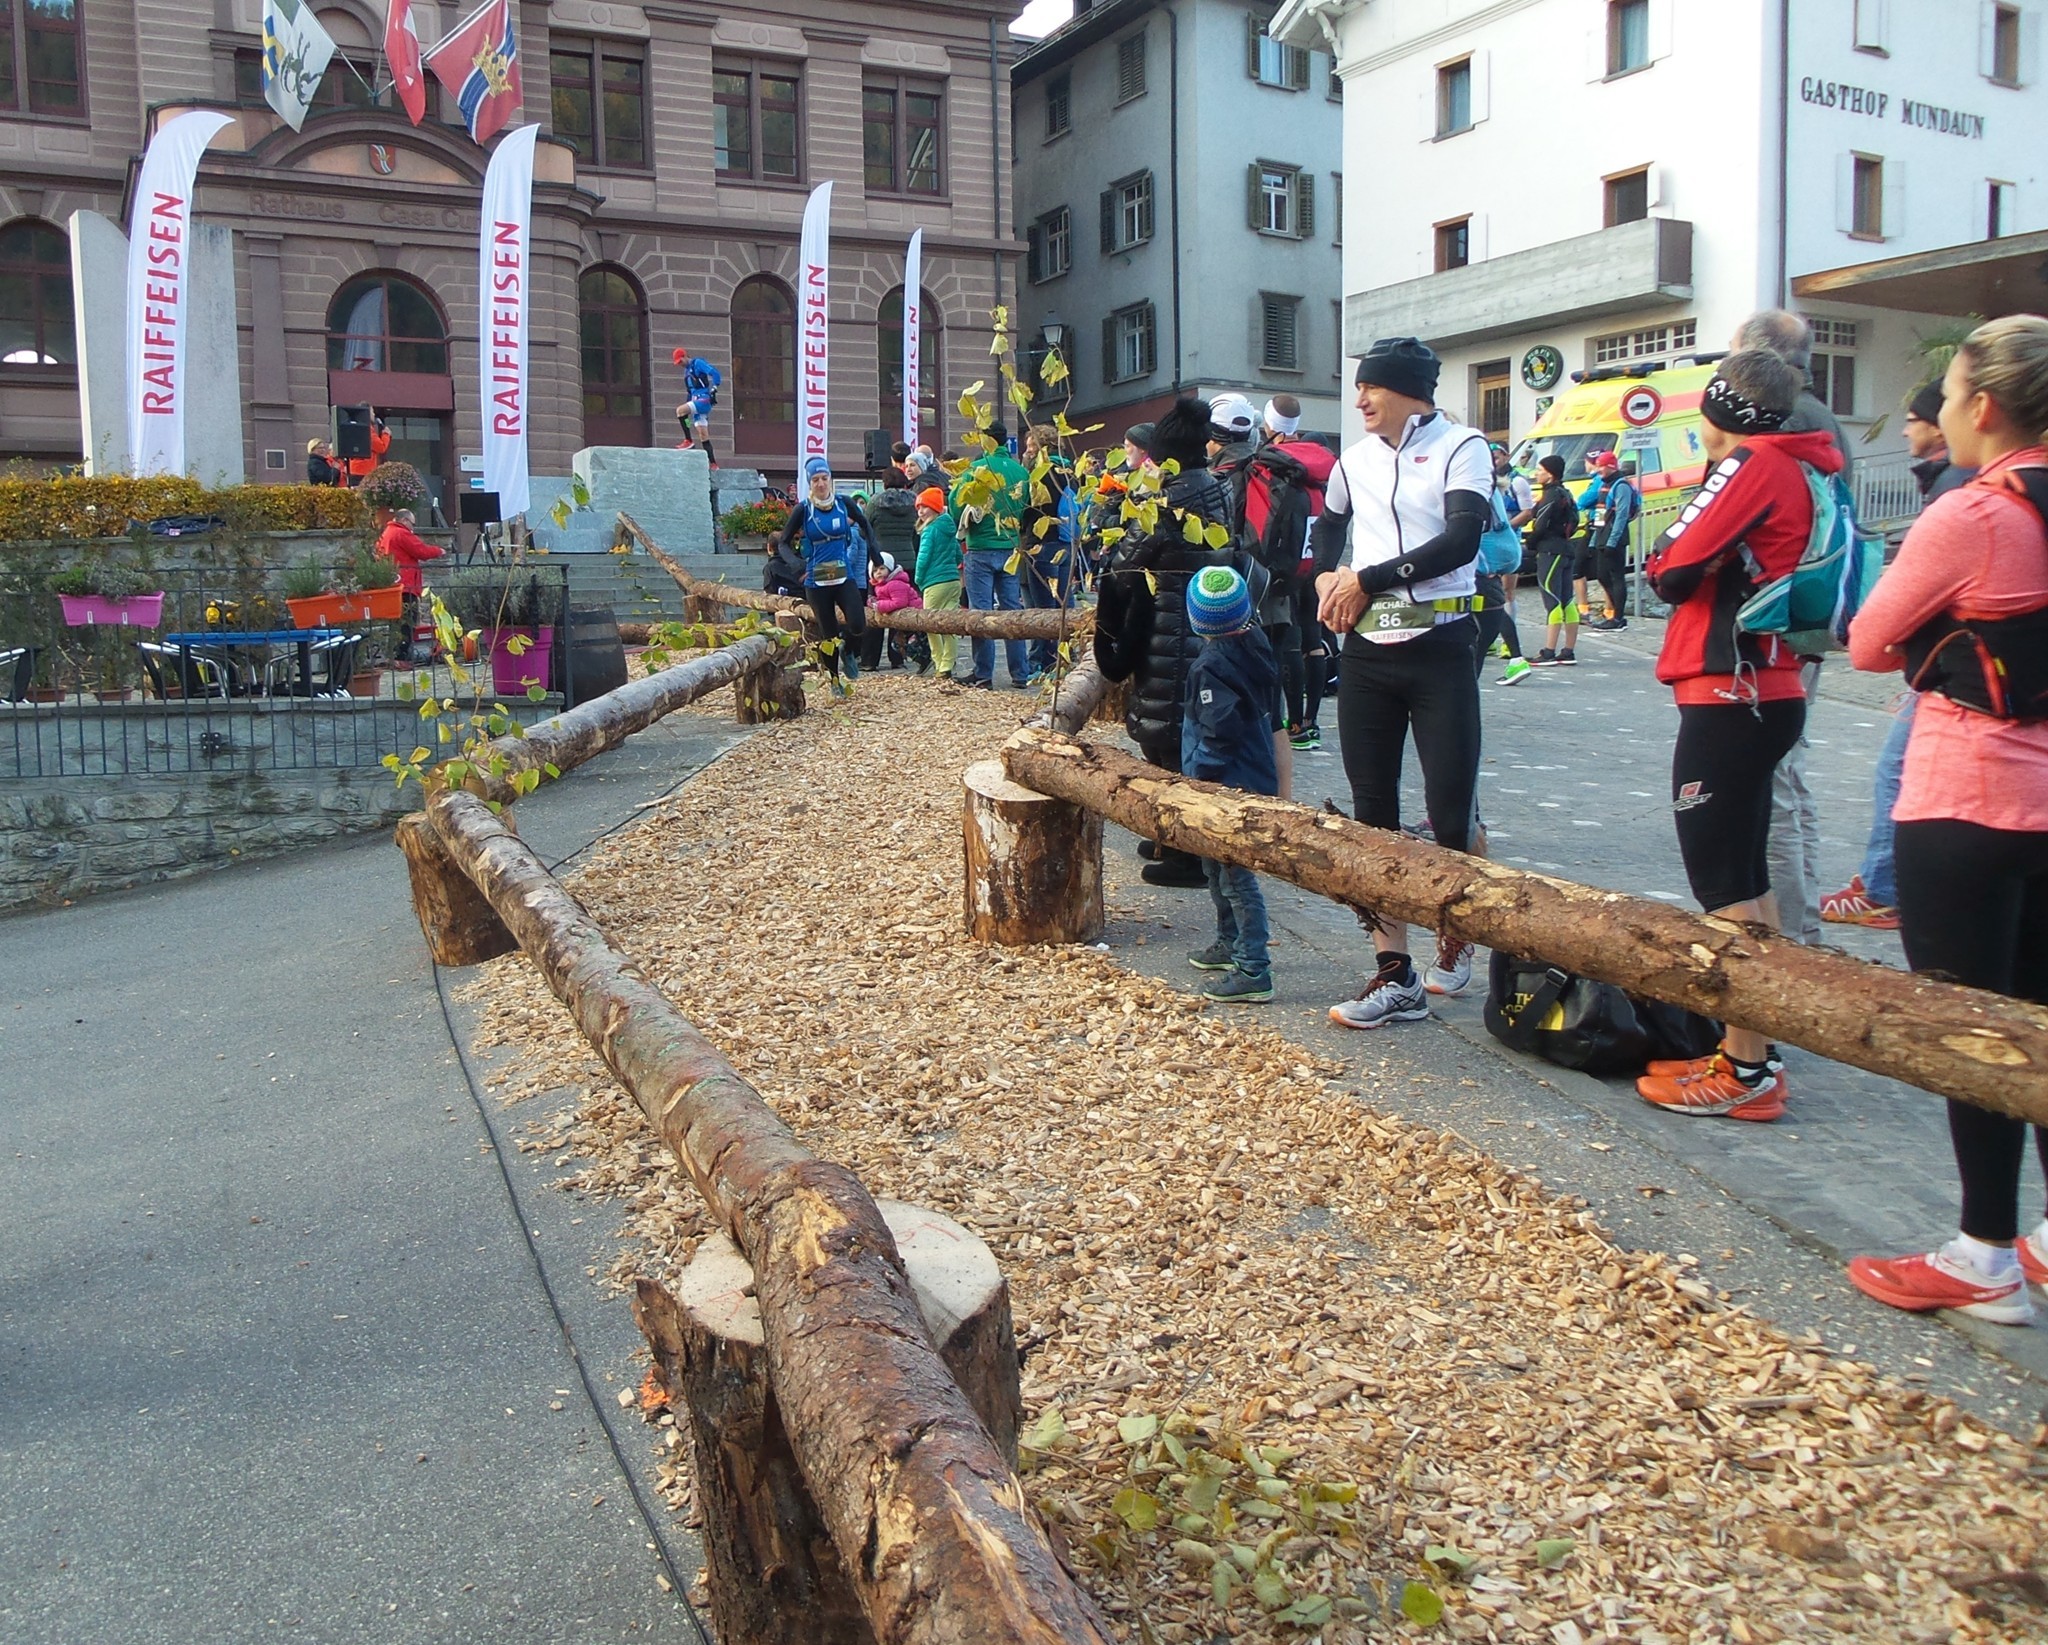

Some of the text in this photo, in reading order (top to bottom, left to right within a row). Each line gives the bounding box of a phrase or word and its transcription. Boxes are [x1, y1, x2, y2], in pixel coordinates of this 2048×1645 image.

[1801, 76, 1985, 140] GASTHOF MUNDAUN
[251, 192, 345, 219] Rathaus
[378, 203, 436, 226] Casa
[143, 192, 184, 414] RAIFFEISEN
[493, 221, 521, 436] RAIFFEISEN
[805, 264, 826, 454] RAIFFEISEN
[1371, 601, 1411, 610] MICHAEL
[1379, 613, 1402, 628] 86
[1514, 992, 1534, 1005] TH
